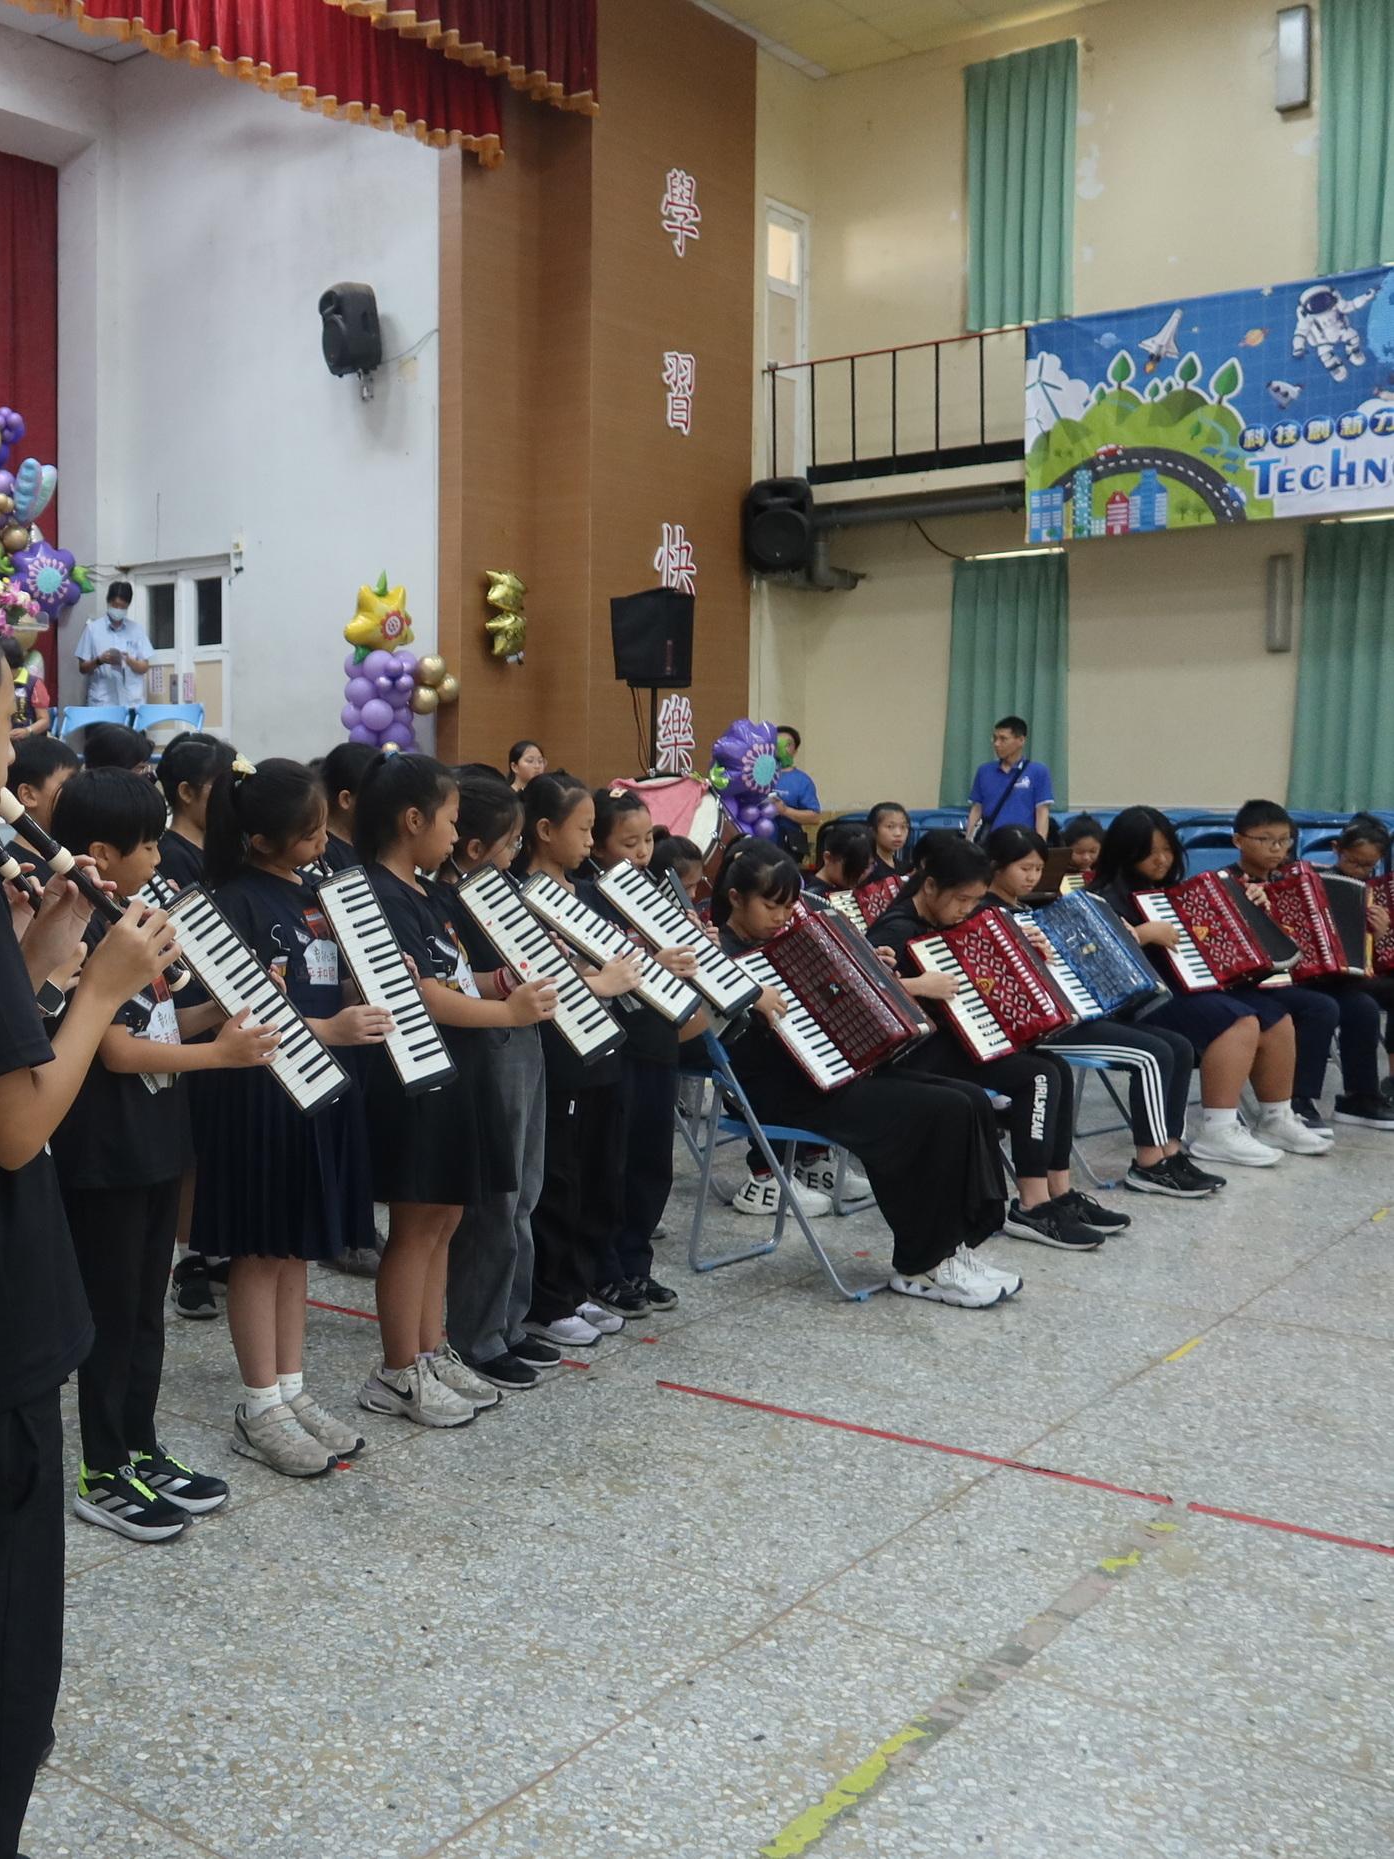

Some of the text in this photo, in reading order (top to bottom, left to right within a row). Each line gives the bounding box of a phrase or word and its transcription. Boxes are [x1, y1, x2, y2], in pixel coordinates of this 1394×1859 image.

[654, 168, 701, 774] 學習快樂
[1248, 447, 1394, 496] TECHN
